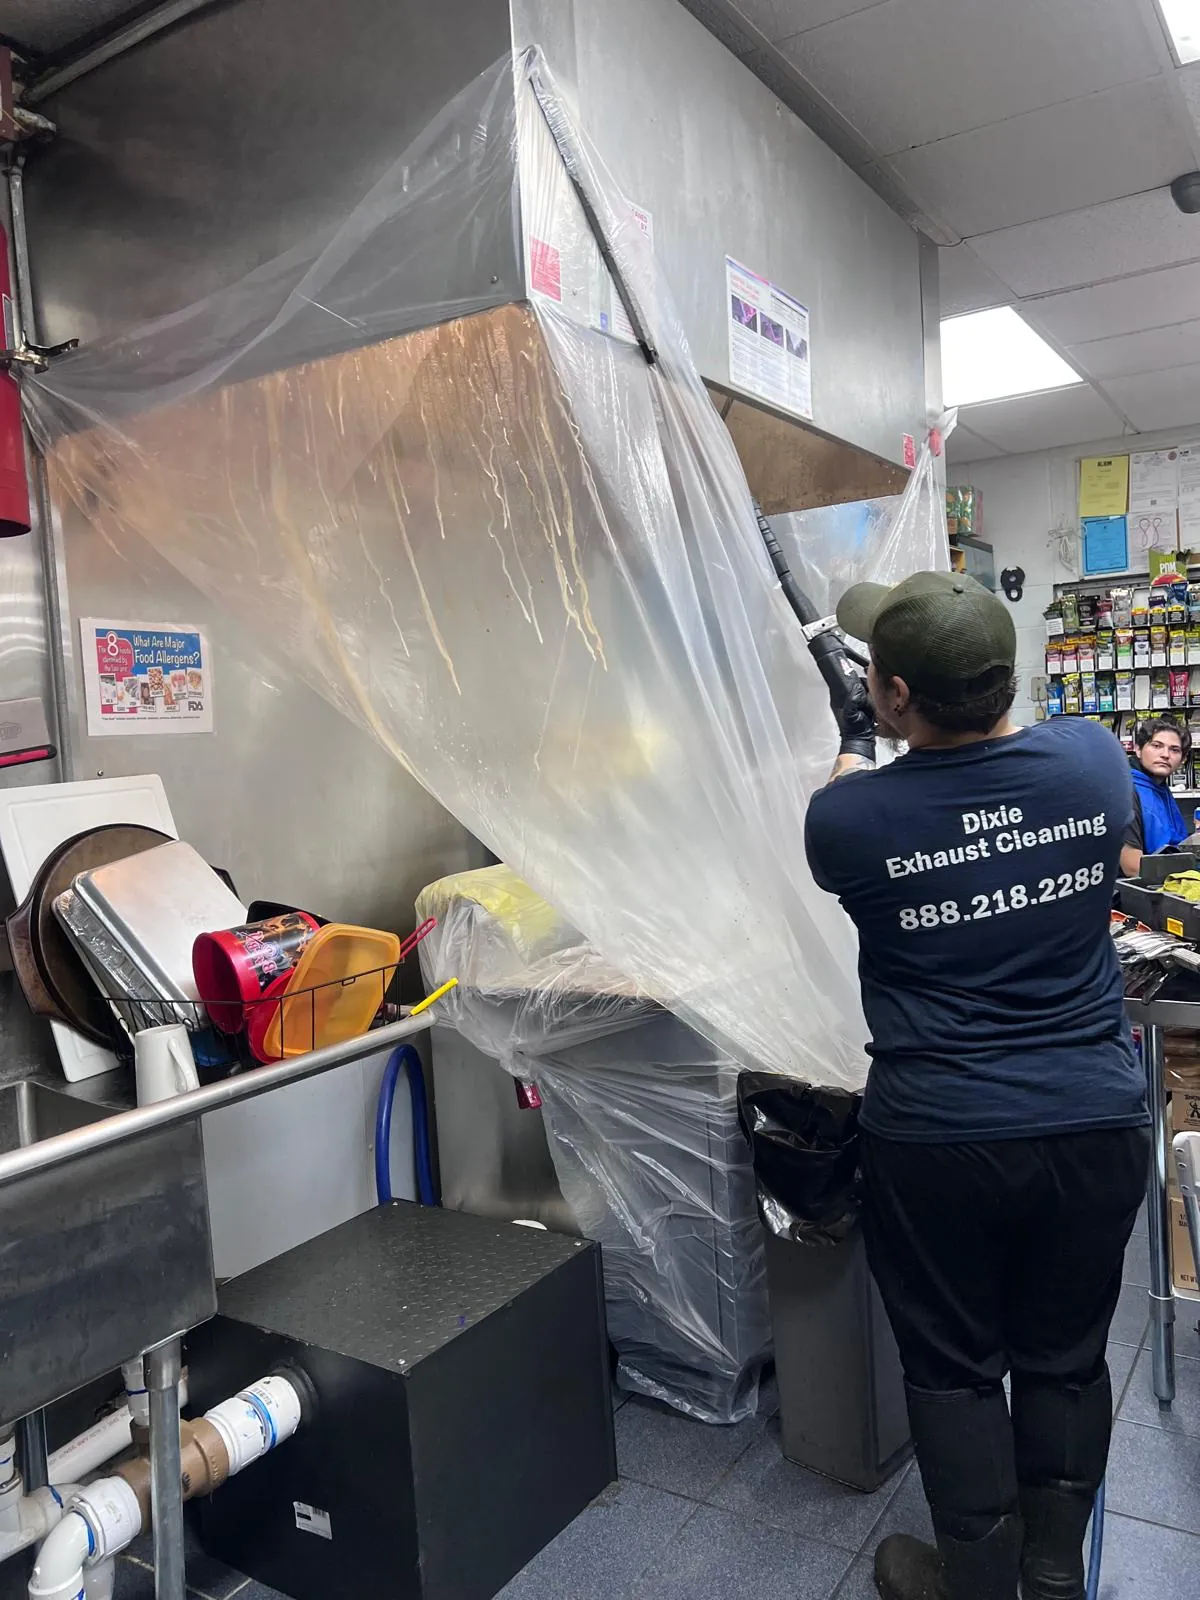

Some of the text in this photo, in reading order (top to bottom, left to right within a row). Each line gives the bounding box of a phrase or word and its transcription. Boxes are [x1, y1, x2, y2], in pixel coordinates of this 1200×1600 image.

[107, 632, 119, 656] 8
[133, 634, 185, 652] What Are Major
[135, 649, 200, 668] Food Allergens?
[188, 700, 203, 711] FDA
[961, 804, 1023, 835] Dixie
[885, 812, 1108, 879] Exhaust Cleaning
[899, 862, 1105, 931] 888.218.2288
